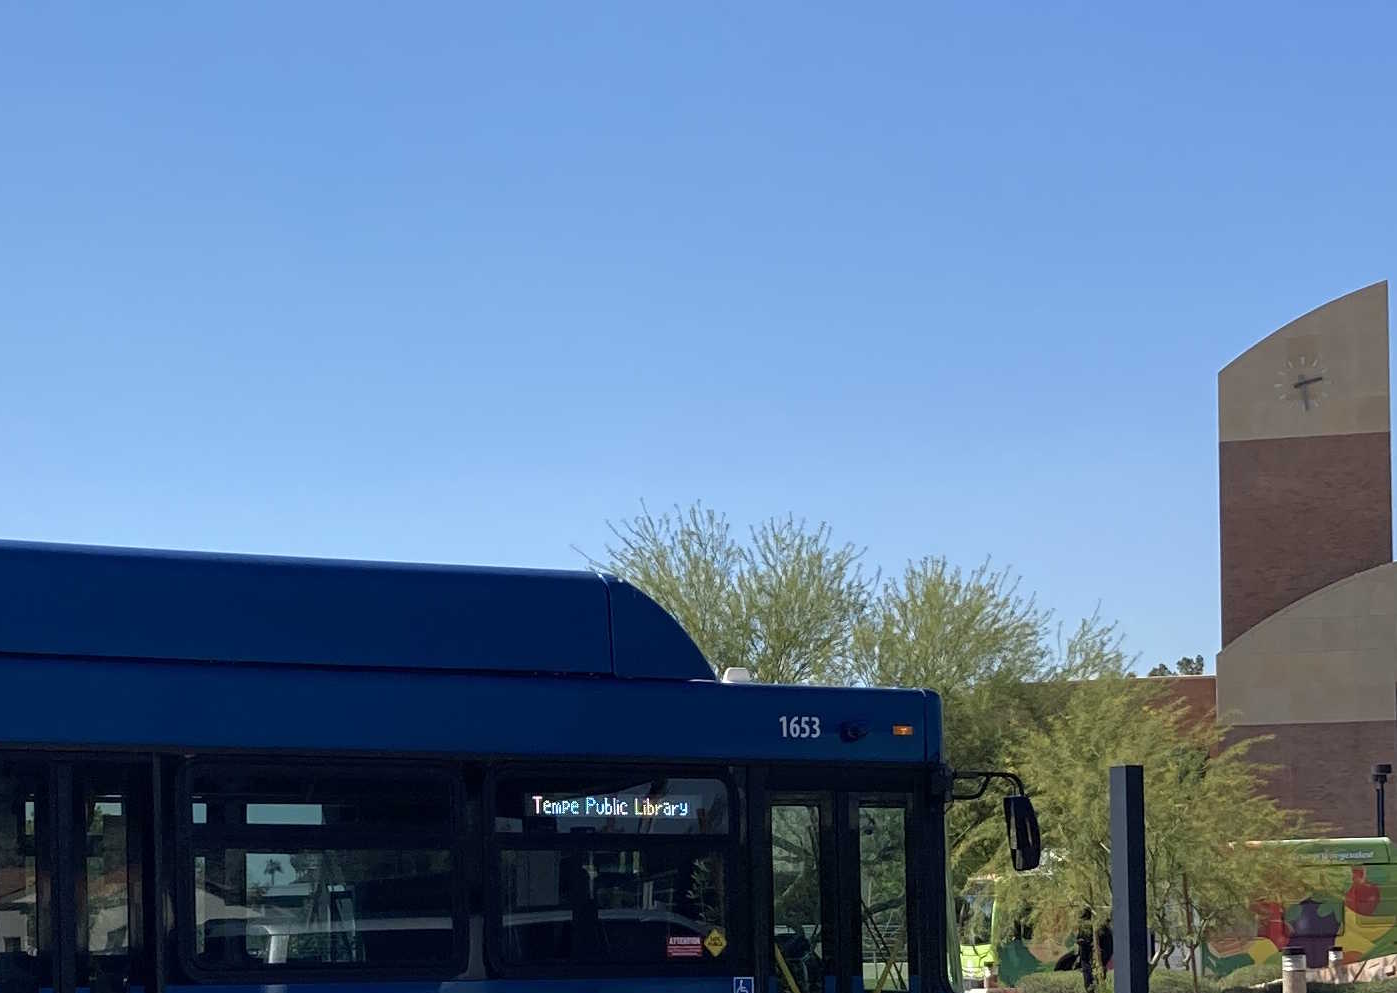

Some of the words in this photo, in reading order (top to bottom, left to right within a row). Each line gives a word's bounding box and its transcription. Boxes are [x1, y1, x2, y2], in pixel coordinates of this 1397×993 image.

[778, 715, 821, 739] 1653
[531, 795, 580, 815] Tempe
[585, 796, 629, 816] Public
[634, 797, 689, 817] Library
